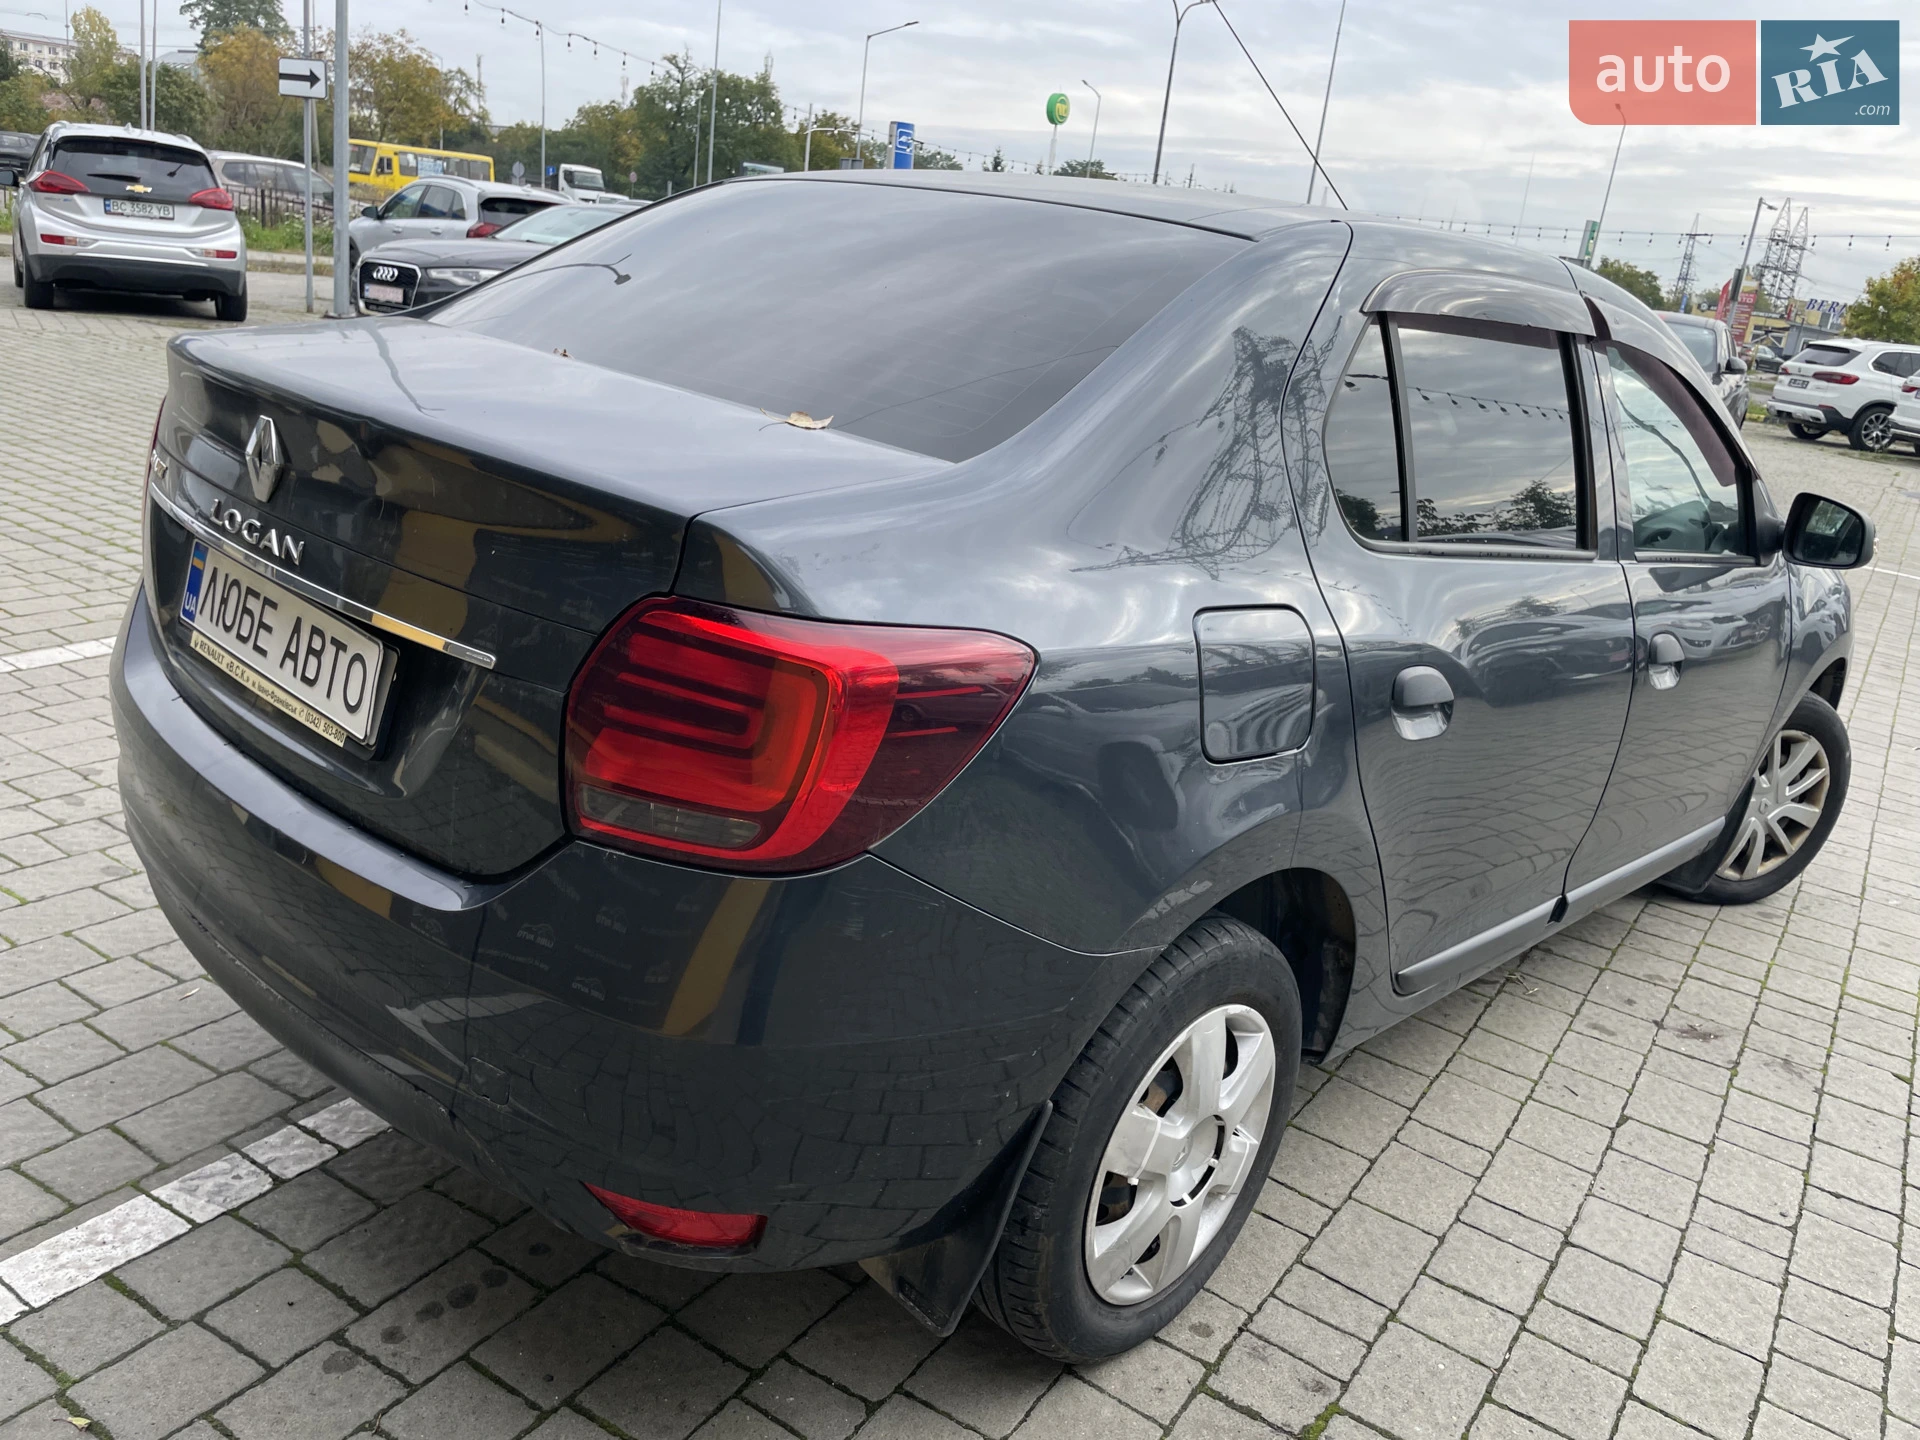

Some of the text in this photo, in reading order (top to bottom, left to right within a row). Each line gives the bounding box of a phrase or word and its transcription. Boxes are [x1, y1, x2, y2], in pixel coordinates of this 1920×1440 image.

[112, 200, 127, 212] BC
[130, 202, 154, 215] 3582
[210, 498, 305, 566] LOGAN
[184, 591, 197, 615] UA
[199, 566, 368, 714] ЛЮБЕ АВТО
[199, 640, 225, 665] RENAULT
[304, 709, 322, 731] (0342)
[322, 722, 345, 744] 503-800
